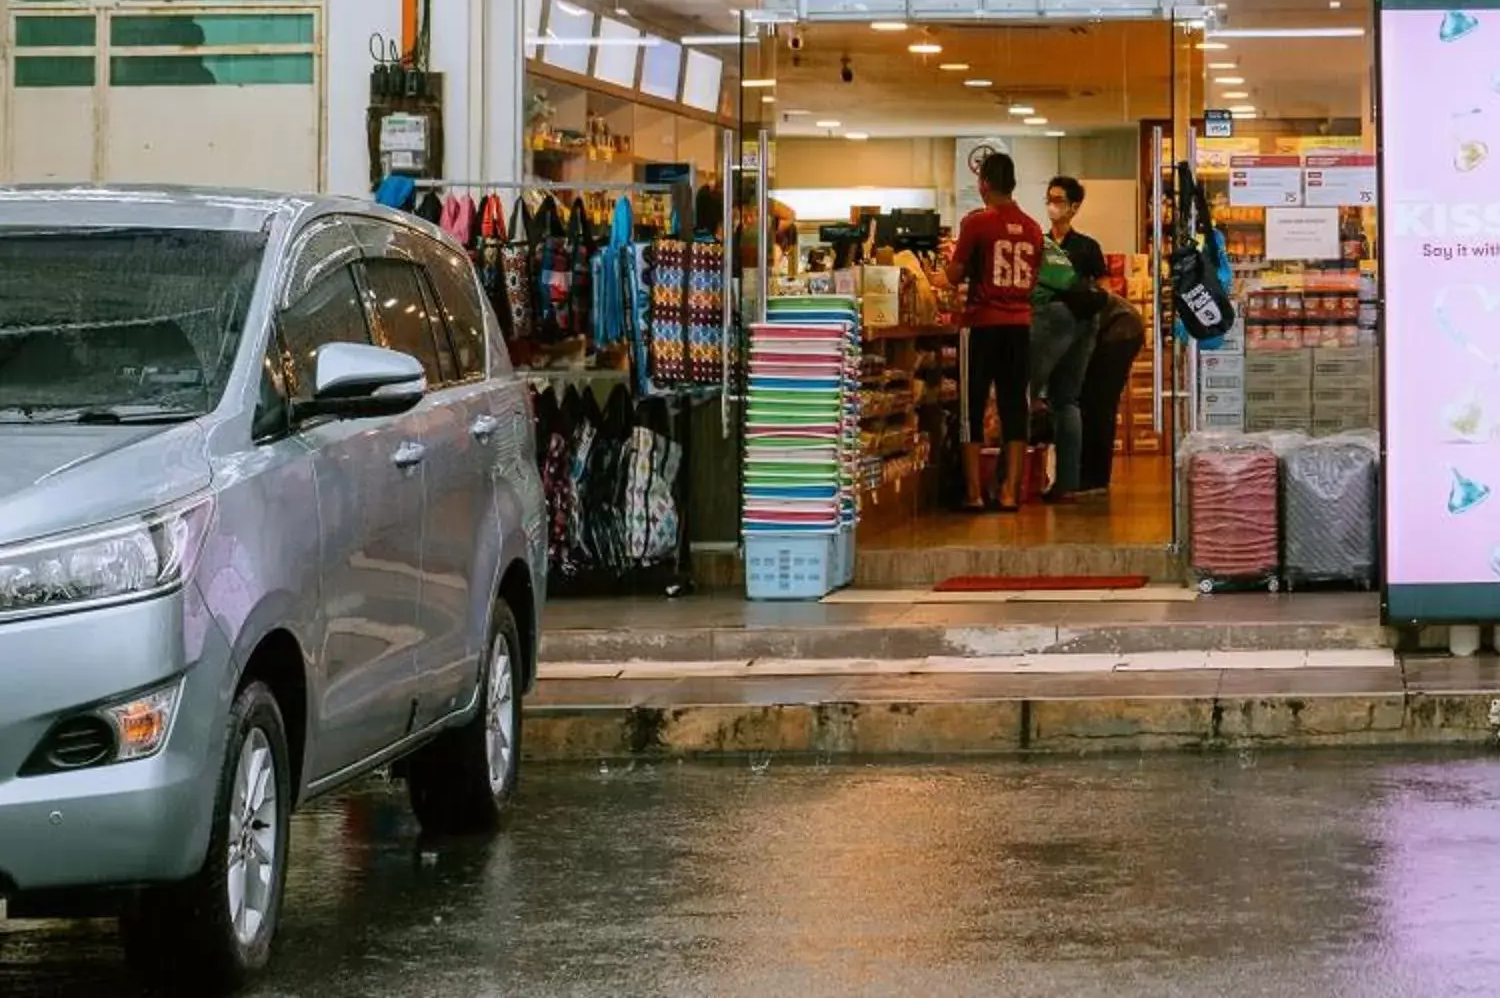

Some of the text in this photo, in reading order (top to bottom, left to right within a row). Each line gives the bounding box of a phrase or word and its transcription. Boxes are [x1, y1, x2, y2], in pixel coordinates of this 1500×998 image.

[992, 239, 1034, 289] 66
[1422, 243, 1453, 261] Say
[1457, 243, 1468, 257] it
